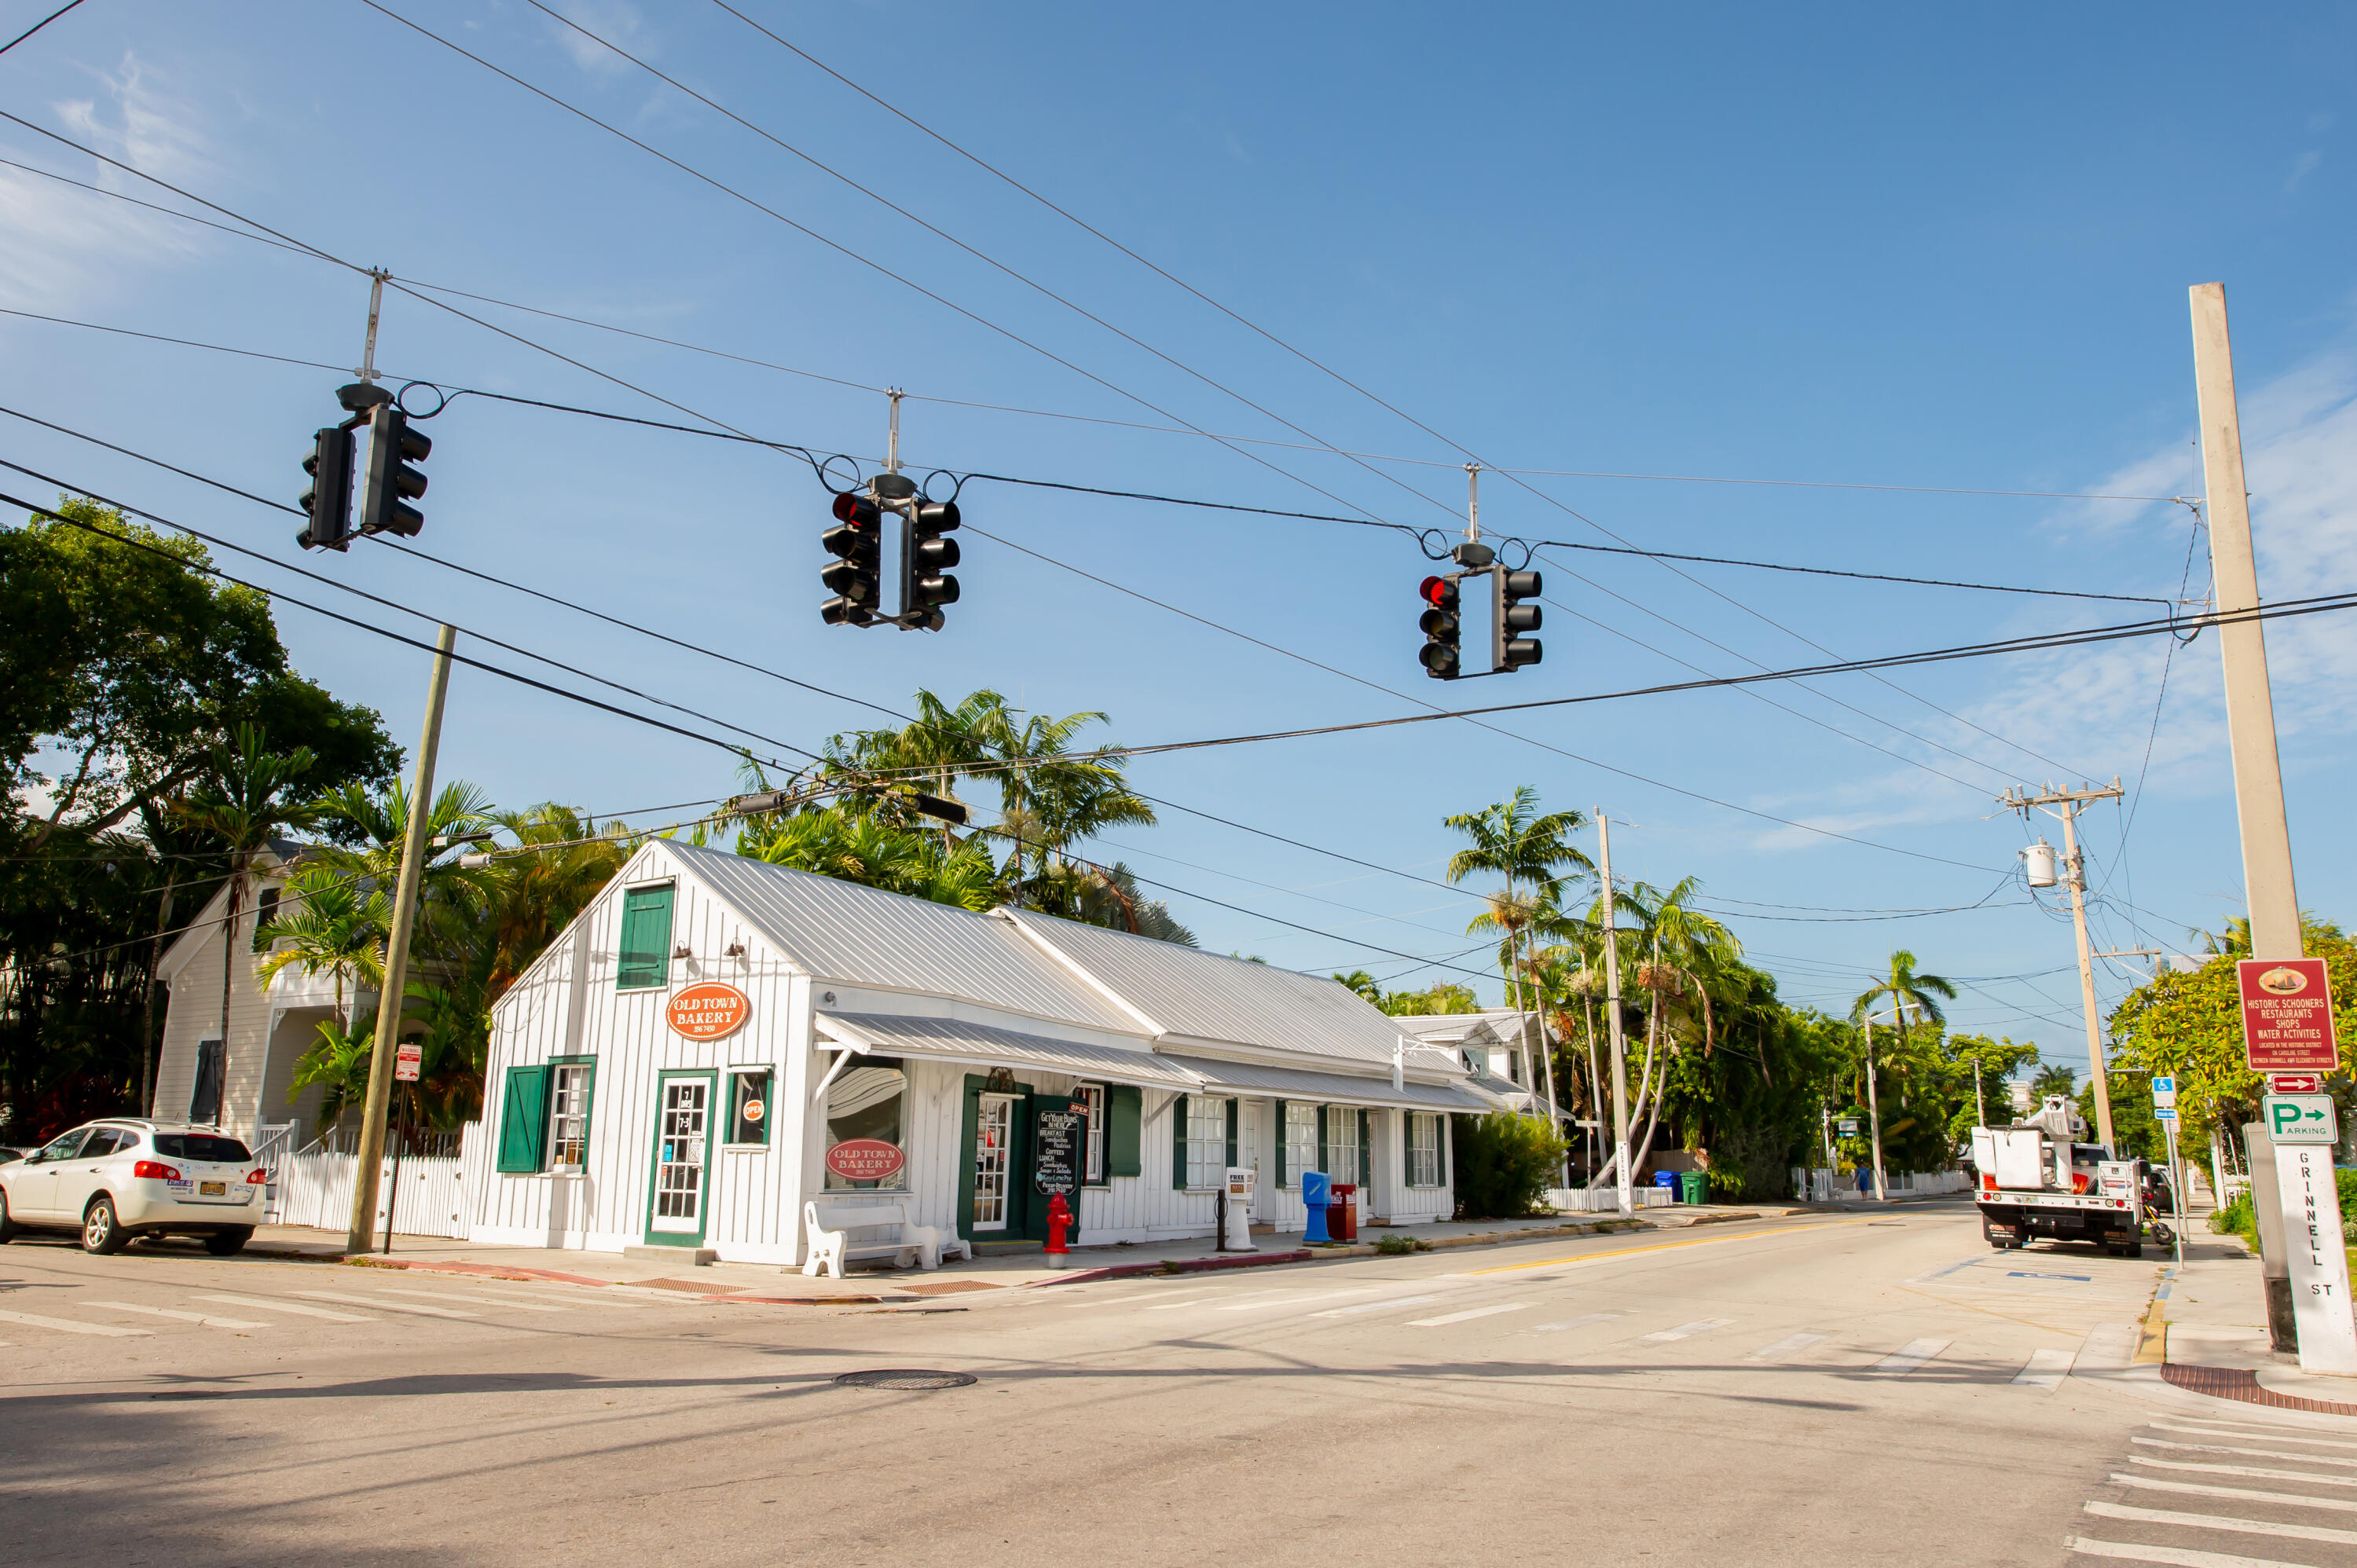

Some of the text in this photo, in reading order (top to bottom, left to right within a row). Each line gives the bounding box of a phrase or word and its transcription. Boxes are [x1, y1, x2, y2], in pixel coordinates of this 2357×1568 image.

[673, 997, 739, 1011] OLD TOWN
[2247, 998, 2325, 1009] HISTORIC SCHOONERS
[676, 1011, 734, 1024] BAKERY
[2261, 1009, 2313, 1019] RESTAURANTS
[2275, 1019, 2300, 1029] SHOPS
[2257, 1028, 2322, 1039] WATER ACTIVITIES
[684, 1091, 689, 1100] 7
[746, 1105, 762, 1115] OPEN
[1071, 1105, 1088, 1113] OPEN
[680, 1117, 690, 1128] 7-3
[834, 1149, 895, 1159] OLD TOWN
[838, 1160, 893, 1169] BAKERY
[2300, 1152, 2322, 1266] GRINNELL
[2311, 1284, 2332, 1296] ST
